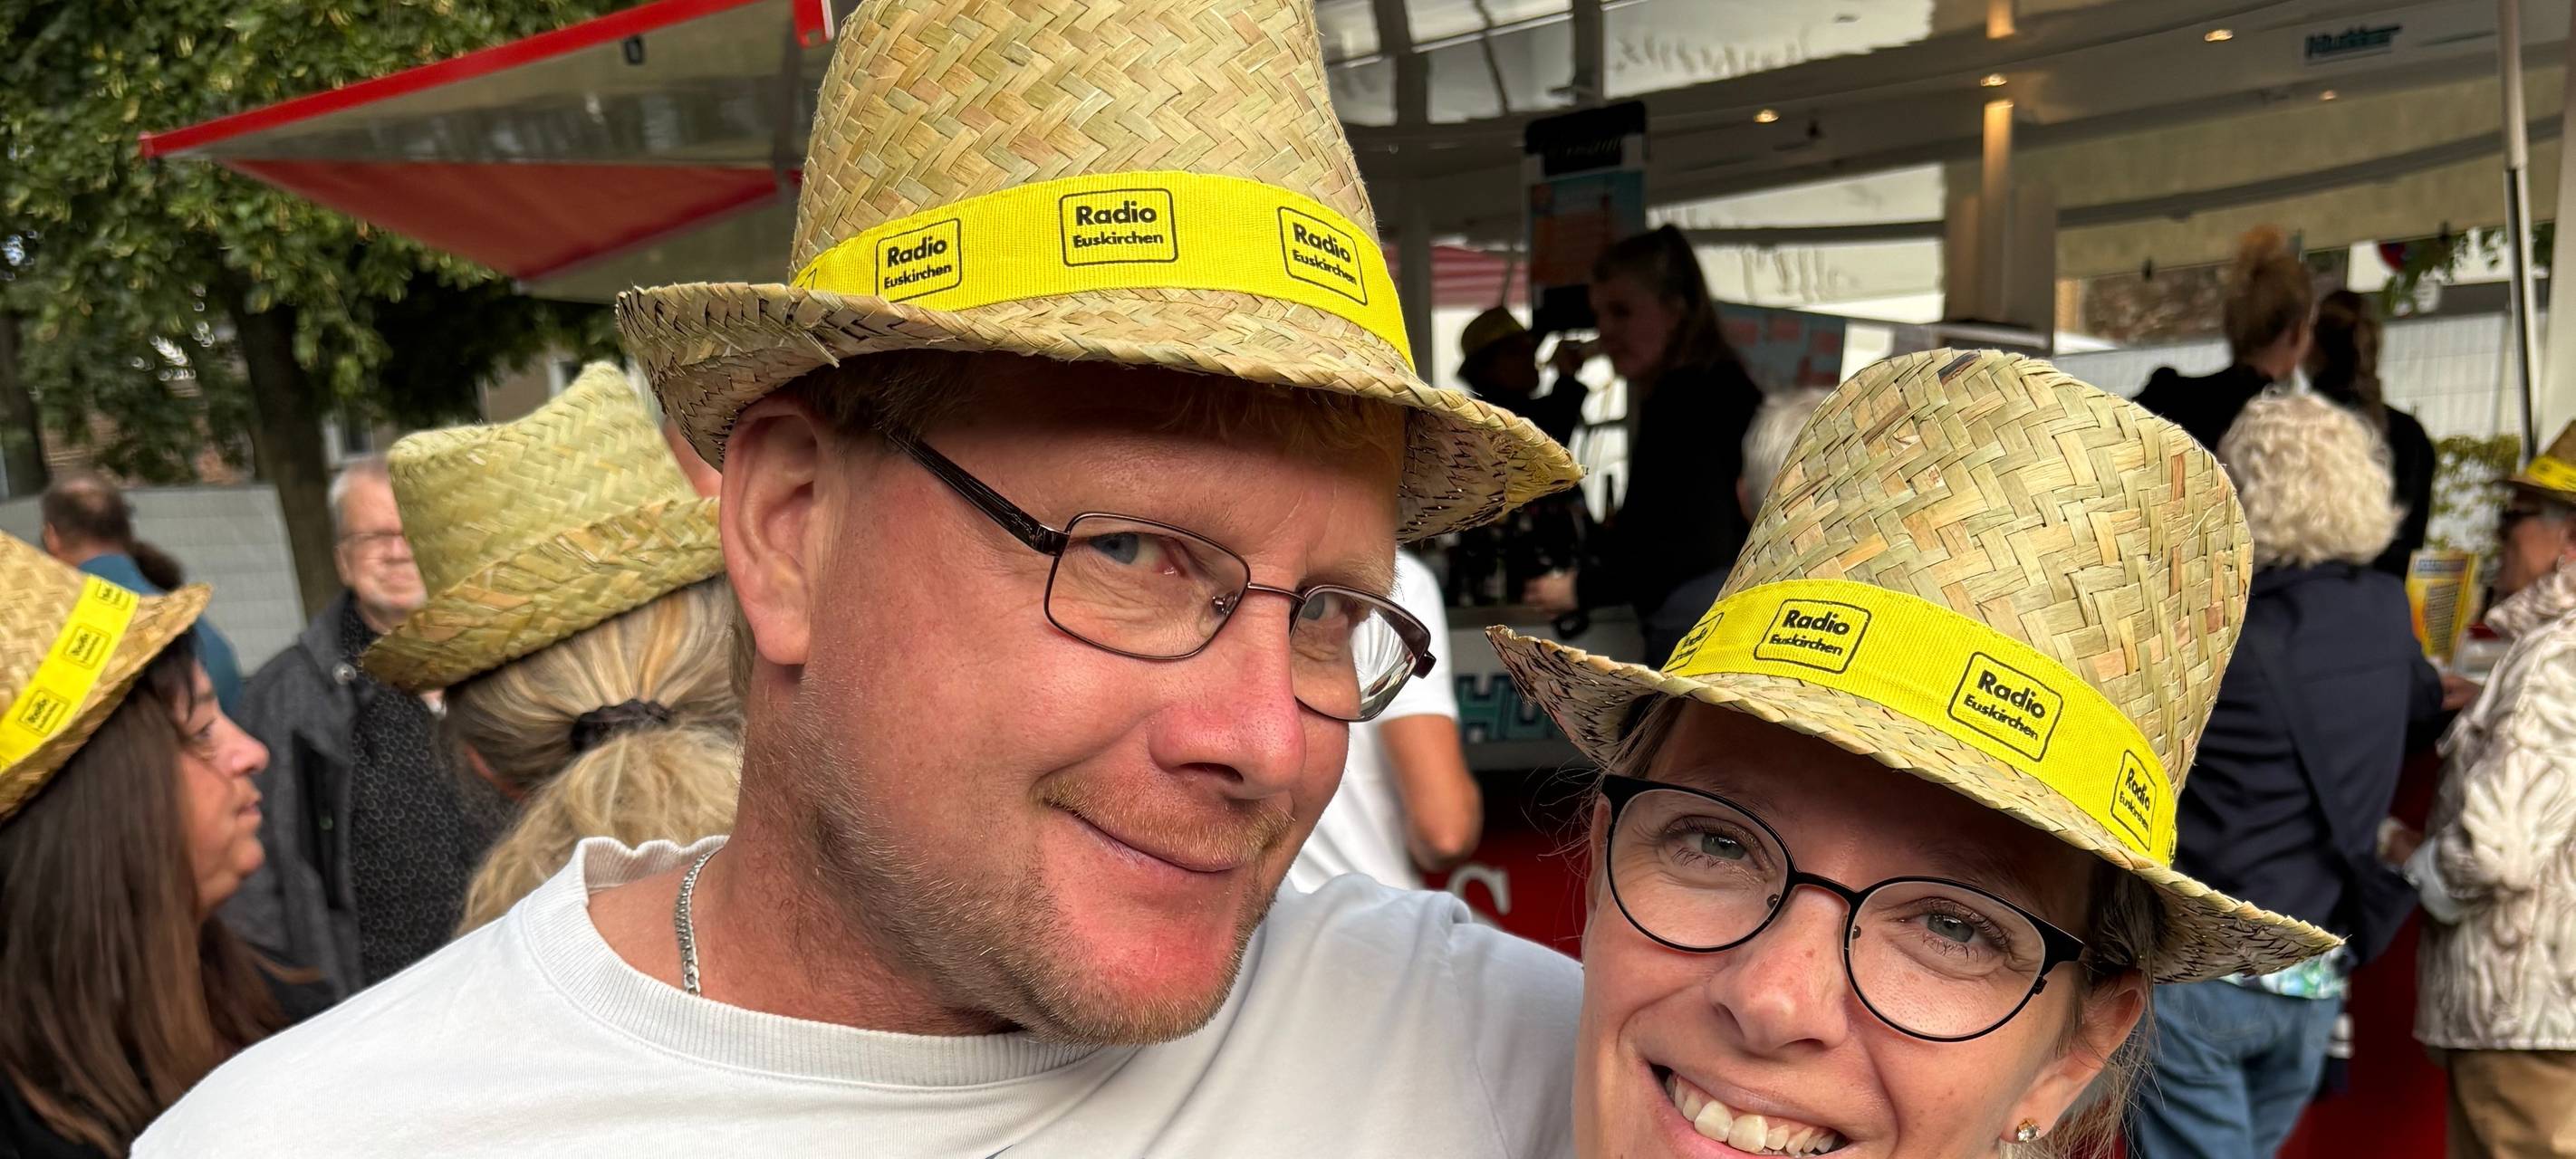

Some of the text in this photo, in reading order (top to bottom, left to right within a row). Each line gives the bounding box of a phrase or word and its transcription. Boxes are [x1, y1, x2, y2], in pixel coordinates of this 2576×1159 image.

[1076, 200, 1157, 226] Radio
[888, 235, 947, 268] Radio
[1072, 231, 1164, 248] Euskirchen
[1293, 222, 1351, 263] Radio
[884, 264, 952, 289] Euskirchen
[1292, 249, 1357, 285] Euskirchen
[1782, 609, 1850, 635] Radio
[1769, 634, 1843, 656] Euskirchen
[1977, 669, 2045, 718] Radio
[1964, 694, 2038, 741] Euskirchen
[2126, 768, 2150, 811] Radio
